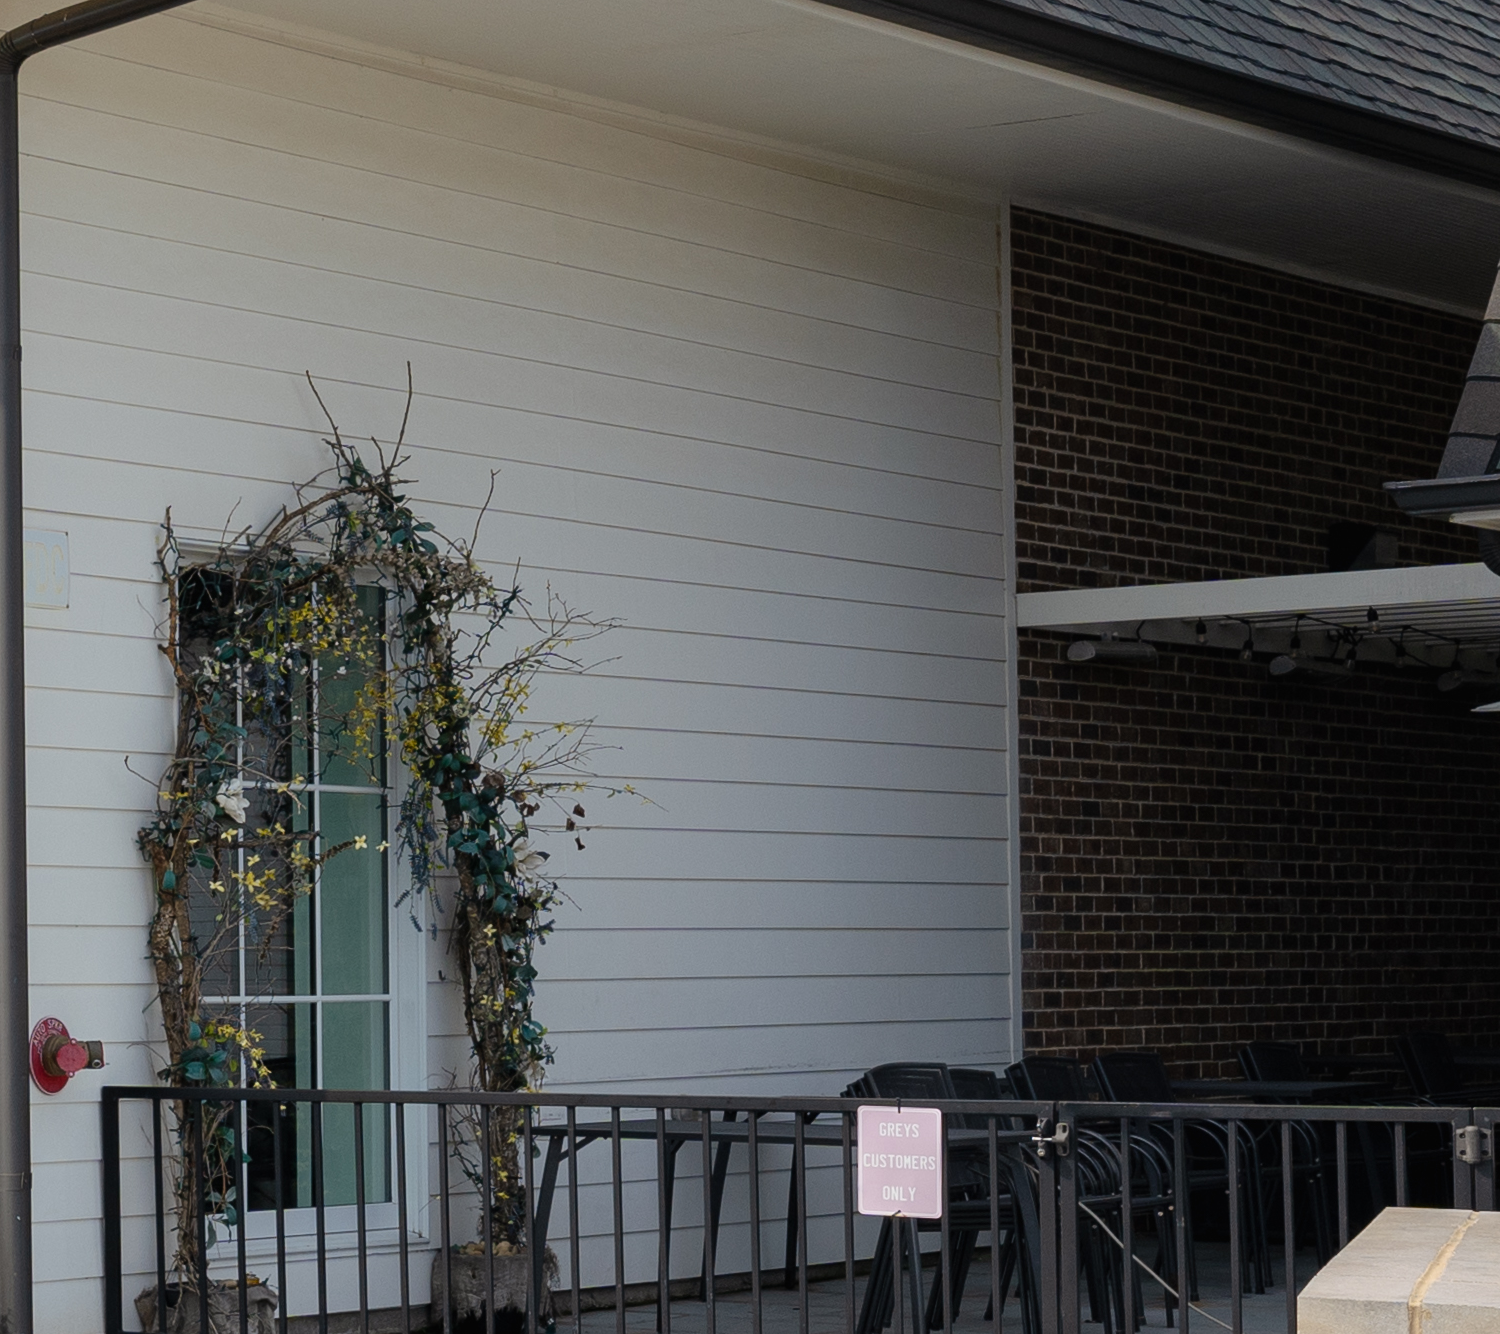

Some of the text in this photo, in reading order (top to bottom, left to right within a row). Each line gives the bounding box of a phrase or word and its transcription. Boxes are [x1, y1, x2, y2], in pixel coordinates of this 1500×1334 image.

[33, 1023, 46, 1046] AUTO
[879, 1123, 919, 1138] GREYS
[863, 1153, 936, 1171] CUSTOMERS
[882, 1186, 916, 1202] ONLY
